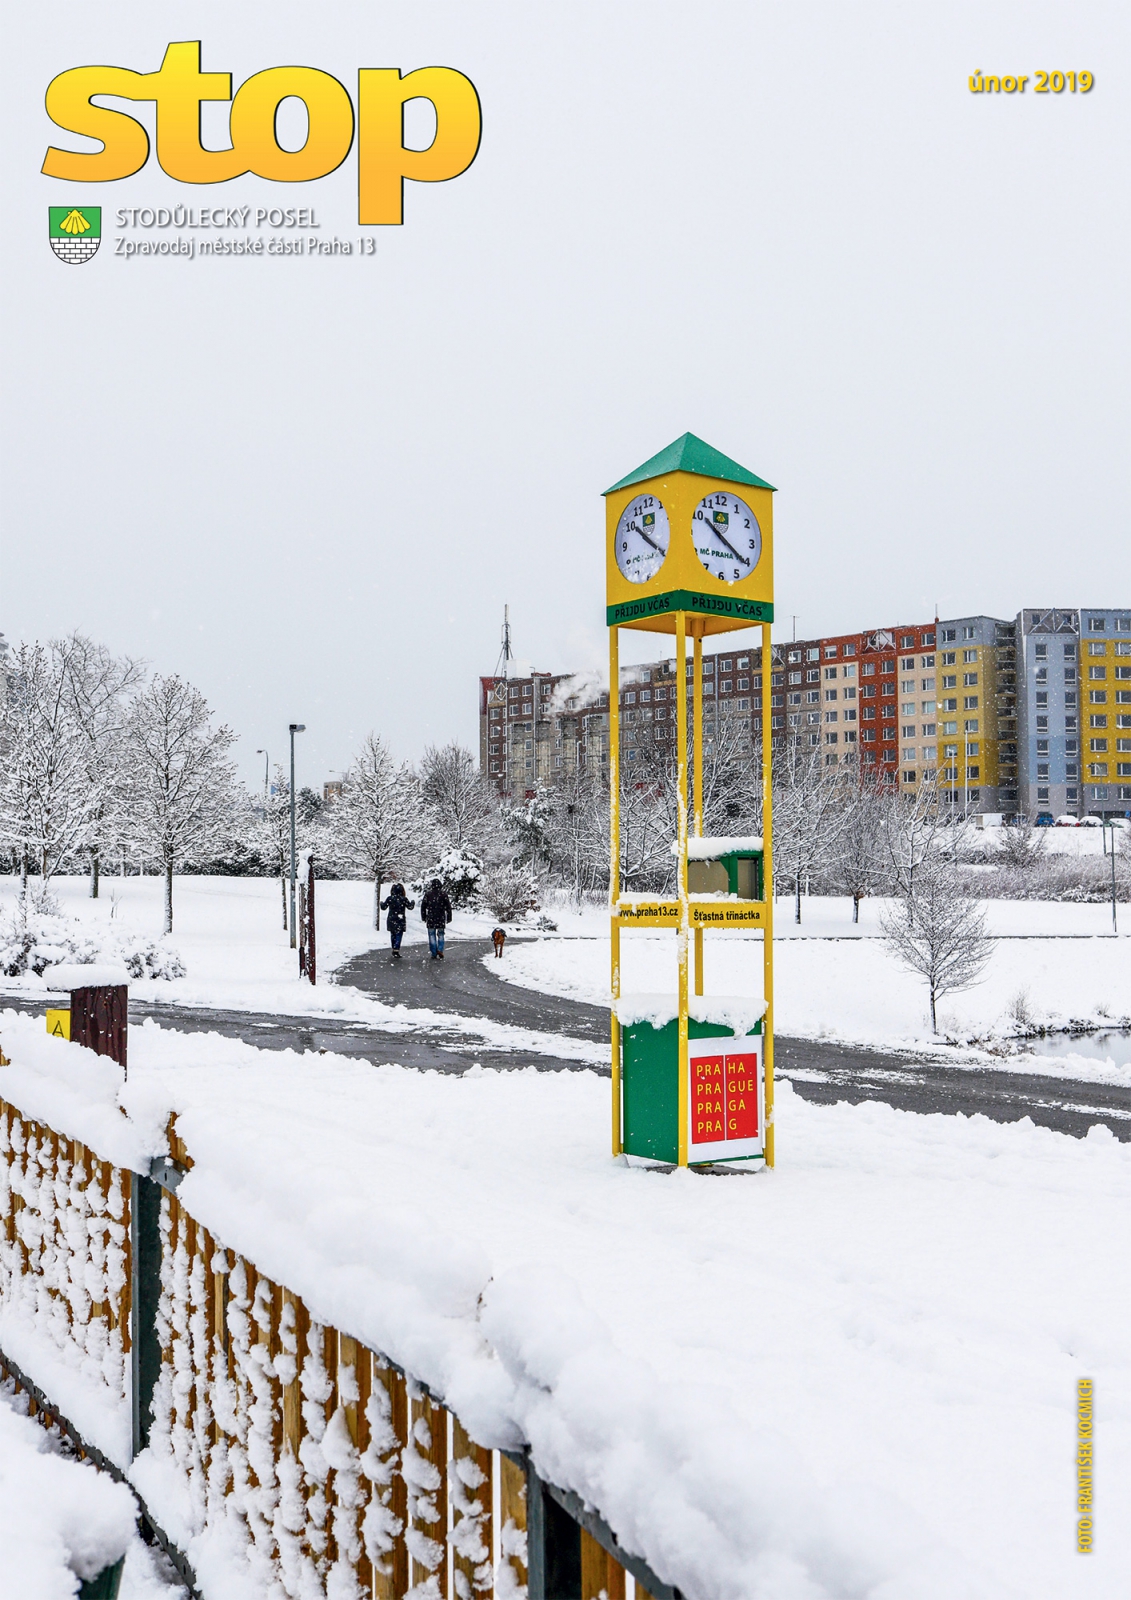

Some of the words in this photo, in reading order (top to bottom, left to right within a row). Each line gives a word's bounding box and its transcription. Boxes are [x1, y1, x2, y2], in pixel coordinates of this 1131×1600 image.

[643, 496, 654, 509] 12
[701, 497, 714, 509] 11
[715, 494, 728, 507] 12
[633, 505, 643, 517] 11
[734, 504, 740, 514] 1
[626, 520, 636, 533] 10
[744, 518, 750, 529] 2
[622, 541, 628, 552] 9
[748, 539, 755, 549] 3
[700, 548, 710, 556] MČ
[711, 550, 734, 560] PRAHA
[733, 569, 740, 579] 5
[615, 602, 646, 619] PŘIJDU
[648, 597, 671, 613] VČAS
[692, 594, 732, 612] PŘIJDU
[734, 601, 763, 617] VČAS
[693, 909, 724, 921] Šťastná
[726, 909, 761, 921] třináctka
[52, 1020, 65, 1039] A
